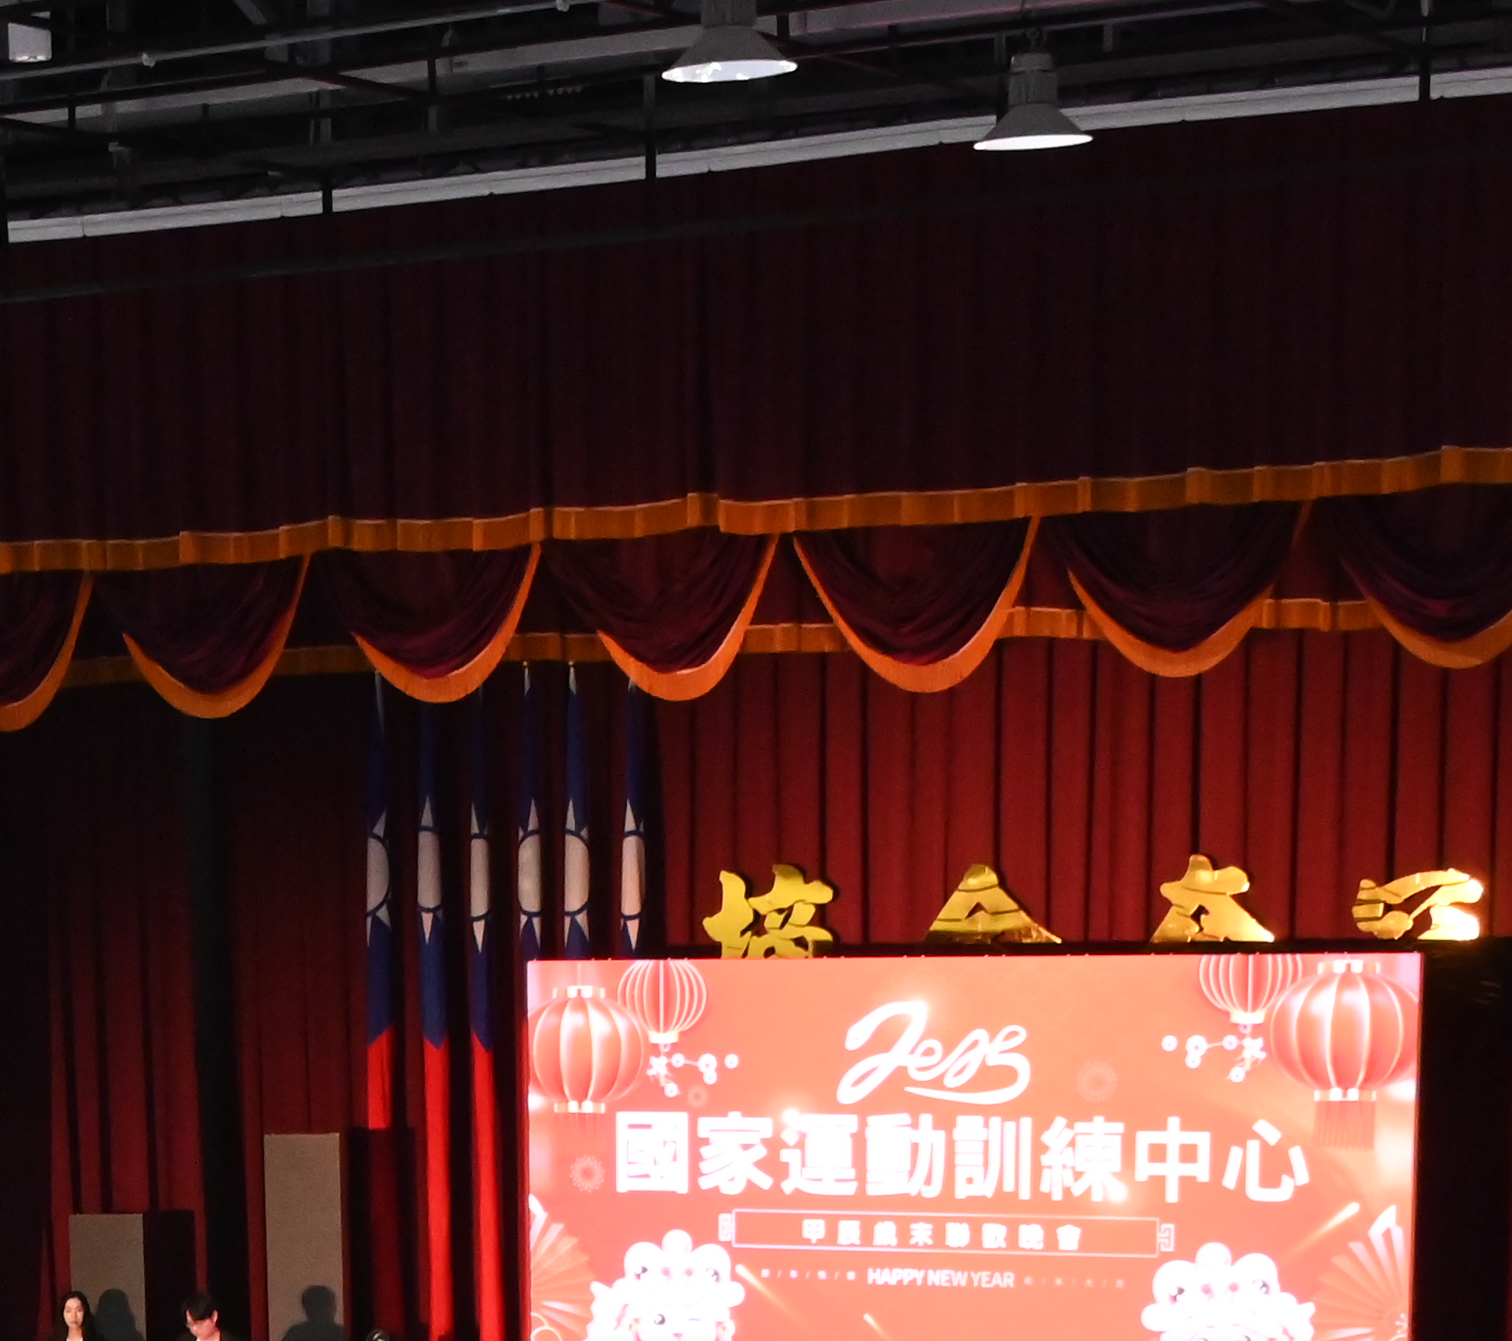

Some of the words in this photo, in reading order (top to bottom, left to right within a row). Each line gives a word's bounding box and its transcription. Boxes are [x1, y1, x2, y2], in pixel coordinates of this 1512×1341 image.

[615, 1110, 1311, 1203] 國家運動訓練中心
[867, 1267, 926, 1286] HAPPY
[927, 1269, 967, 1288] NEW
[969, 1270, 1015, 1289] YEAR
